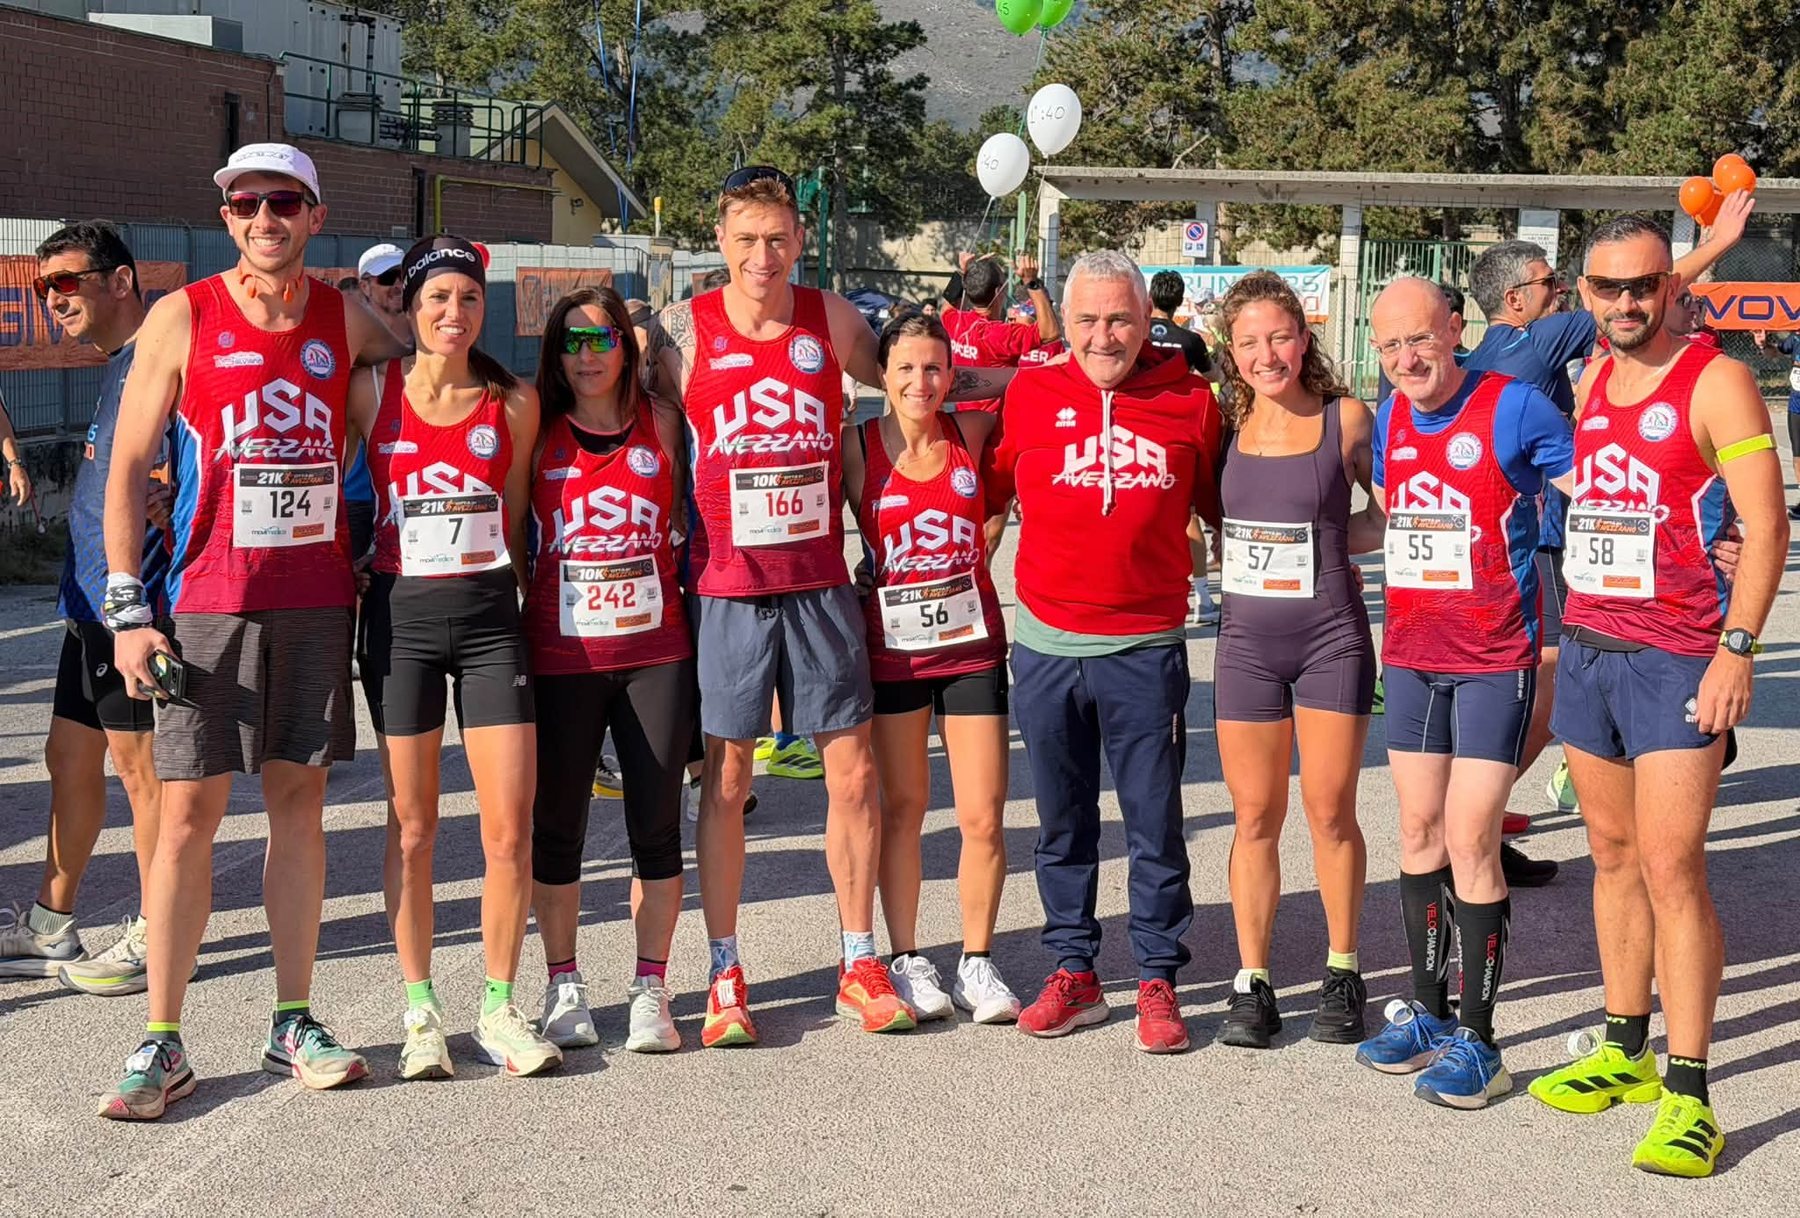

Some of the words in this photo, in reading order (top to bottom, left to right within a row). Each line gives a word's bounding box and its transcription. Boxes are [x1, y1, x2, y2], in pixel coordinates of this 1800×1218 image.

[408, 248, 476, 279] balance
[1702, 295, 1800, 321] VOV
[221, 377, 333, 441] USA
[713, 376, 825, 437] USA
[213, 436, 337, 462] AVEZZANO
[707, 430, 834, 457] AVEZZANO
[1064, 424, 1168, 474] USA
[257, 471, 284, 484] 21K
[388, 461, 493, 499] USA
[752, 474, 778, 488] 10K
[1572, 442, 1660, 504] USA
[269, 489, 311, 518] 124
[420, 501, 446, 514] 21K
[552, 485, 660, 540] USA
[765, 489, 804, 518] 166
[449, 518, 463, 545] 7
[884, 508, 976, 562] USA
[1234, 527, 1252, 540] 21K
[1397, 516, 1413, 528] 21K
[1577, 518, 1596, 531] 21K
[549, 531, 663, 554] AVEZZANO
[1408, 534, 1433, 560] 55
[1588, 537, 1614, 565] 58
[1248, 545, 1275, 571] 57
[578, 567, 604, 581] 10K
[587, 582, 636, 611] 242
[900, 589, 923, 603] 21K
[920, 601, 949, 628] 56
